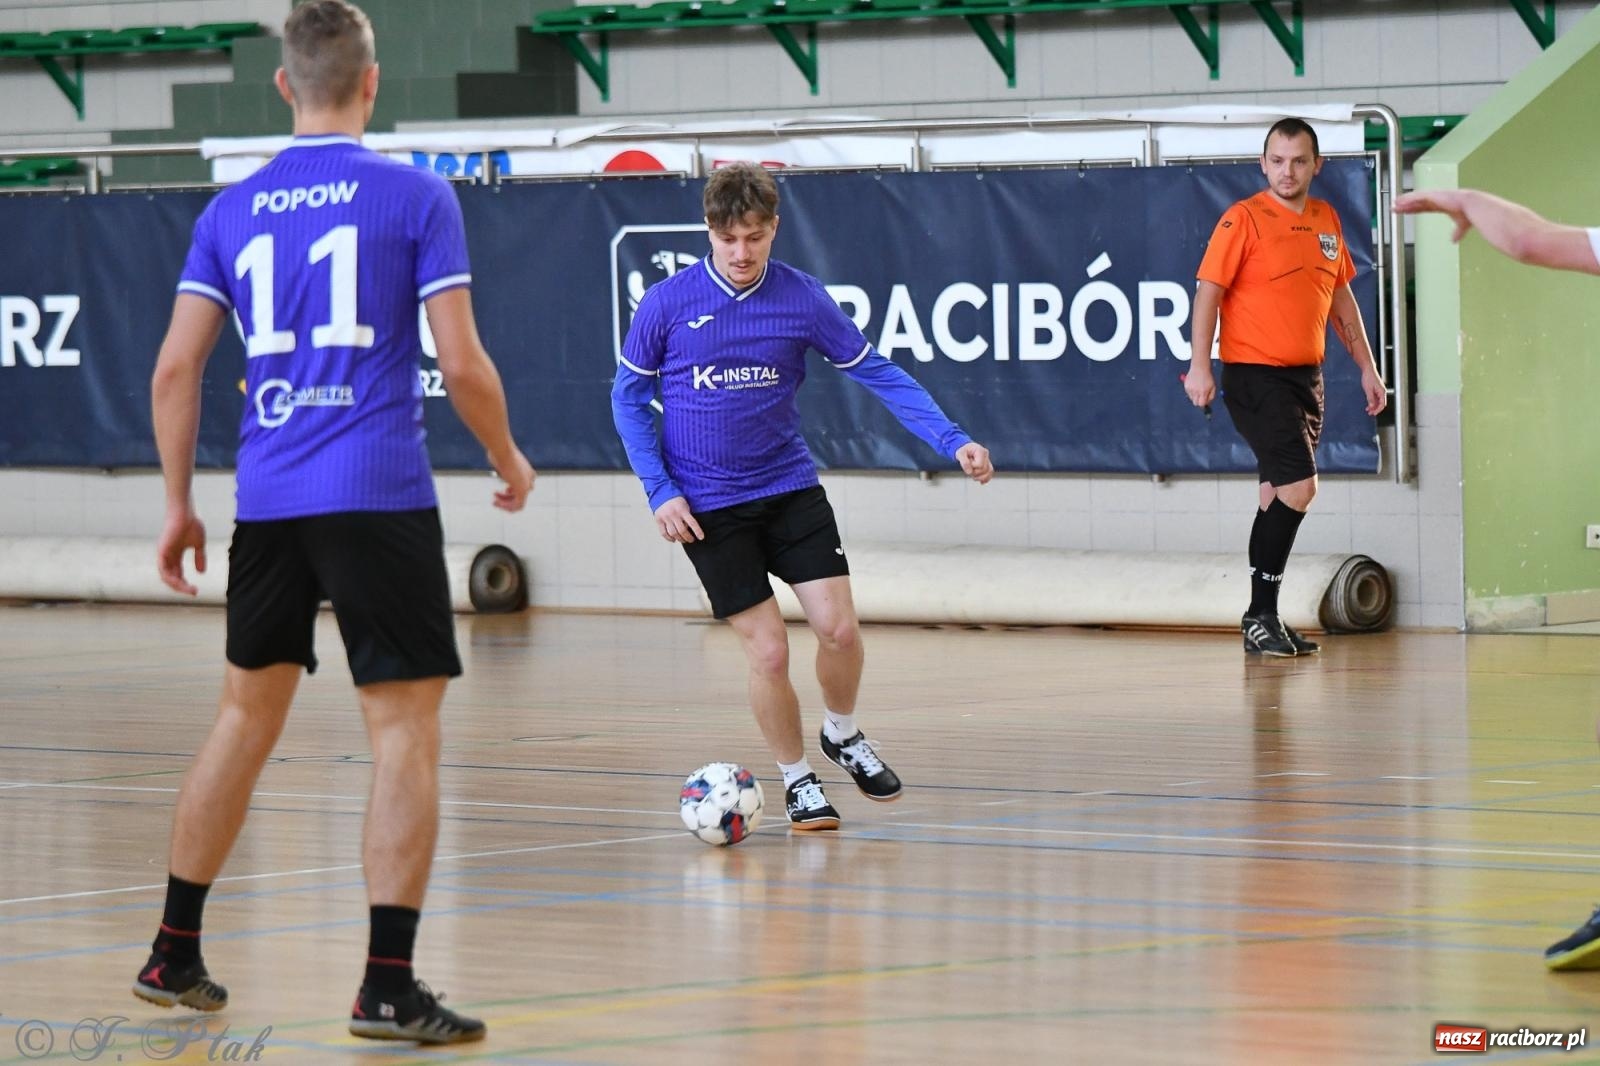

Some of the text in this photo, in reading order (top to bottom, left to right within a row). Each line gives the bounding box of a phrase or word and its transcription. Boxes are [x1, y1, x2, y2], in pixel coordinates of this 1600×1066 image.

[252, 180, 359, 216] POPOW
[234, 224, 375, 359] 11
[692, 364, 780, 390] K-INSTAL
